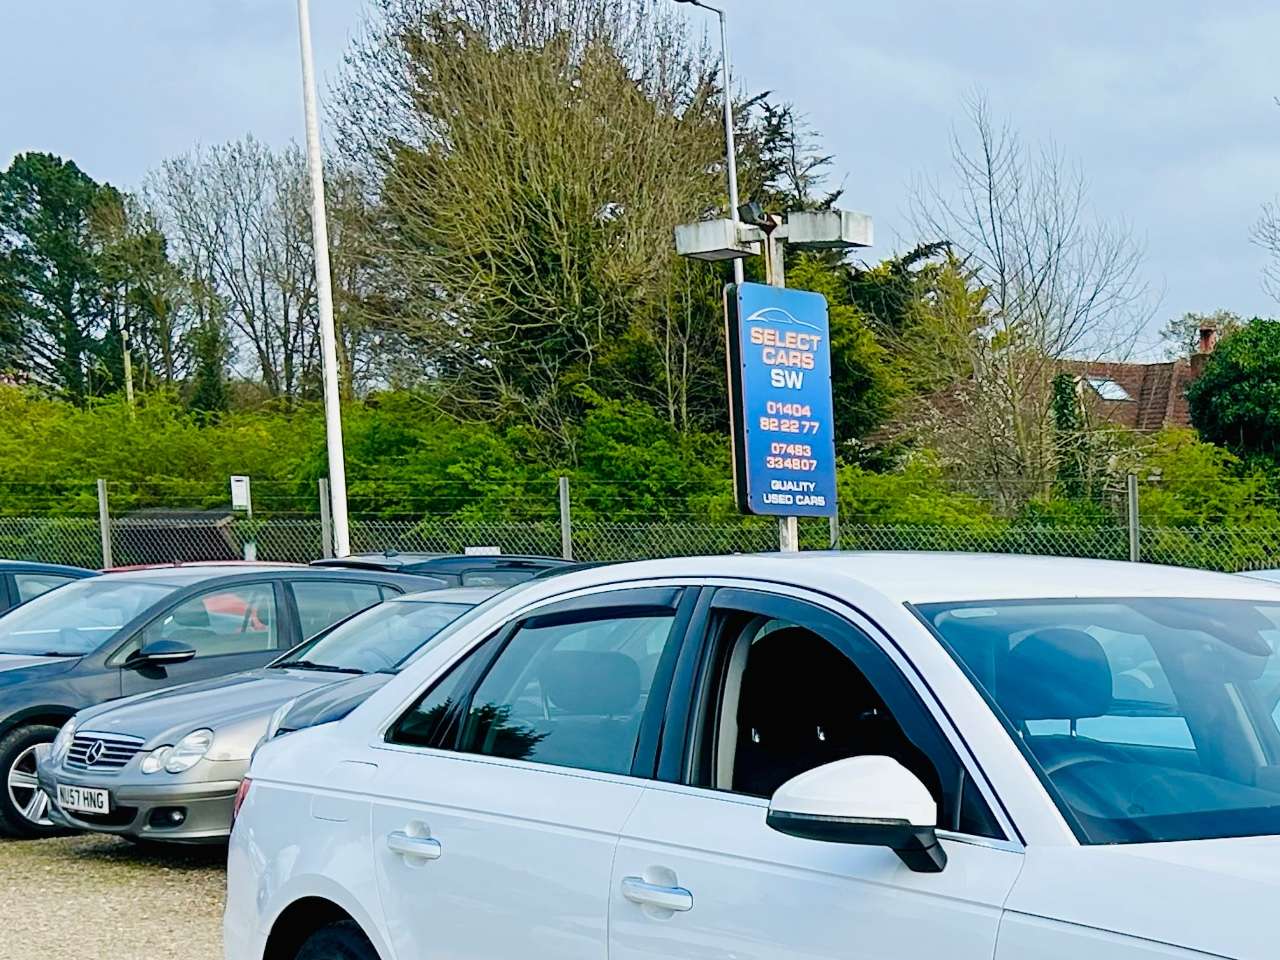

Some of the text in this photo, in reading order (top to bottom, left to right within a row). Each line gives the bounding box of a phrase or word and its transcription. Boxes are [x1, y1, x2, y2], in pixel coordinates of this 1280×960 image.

[751, 326, 822, 351] SELECT
[763, 347, 815, 370] CARS
[771, 368, 803, 389] SW
[766, 401, 811, 417] 01404
[771, 480, 816, 492] QUALITY
[763, 493, 826, 506] USED CARS
[83, 790, 104, 809] HNG
